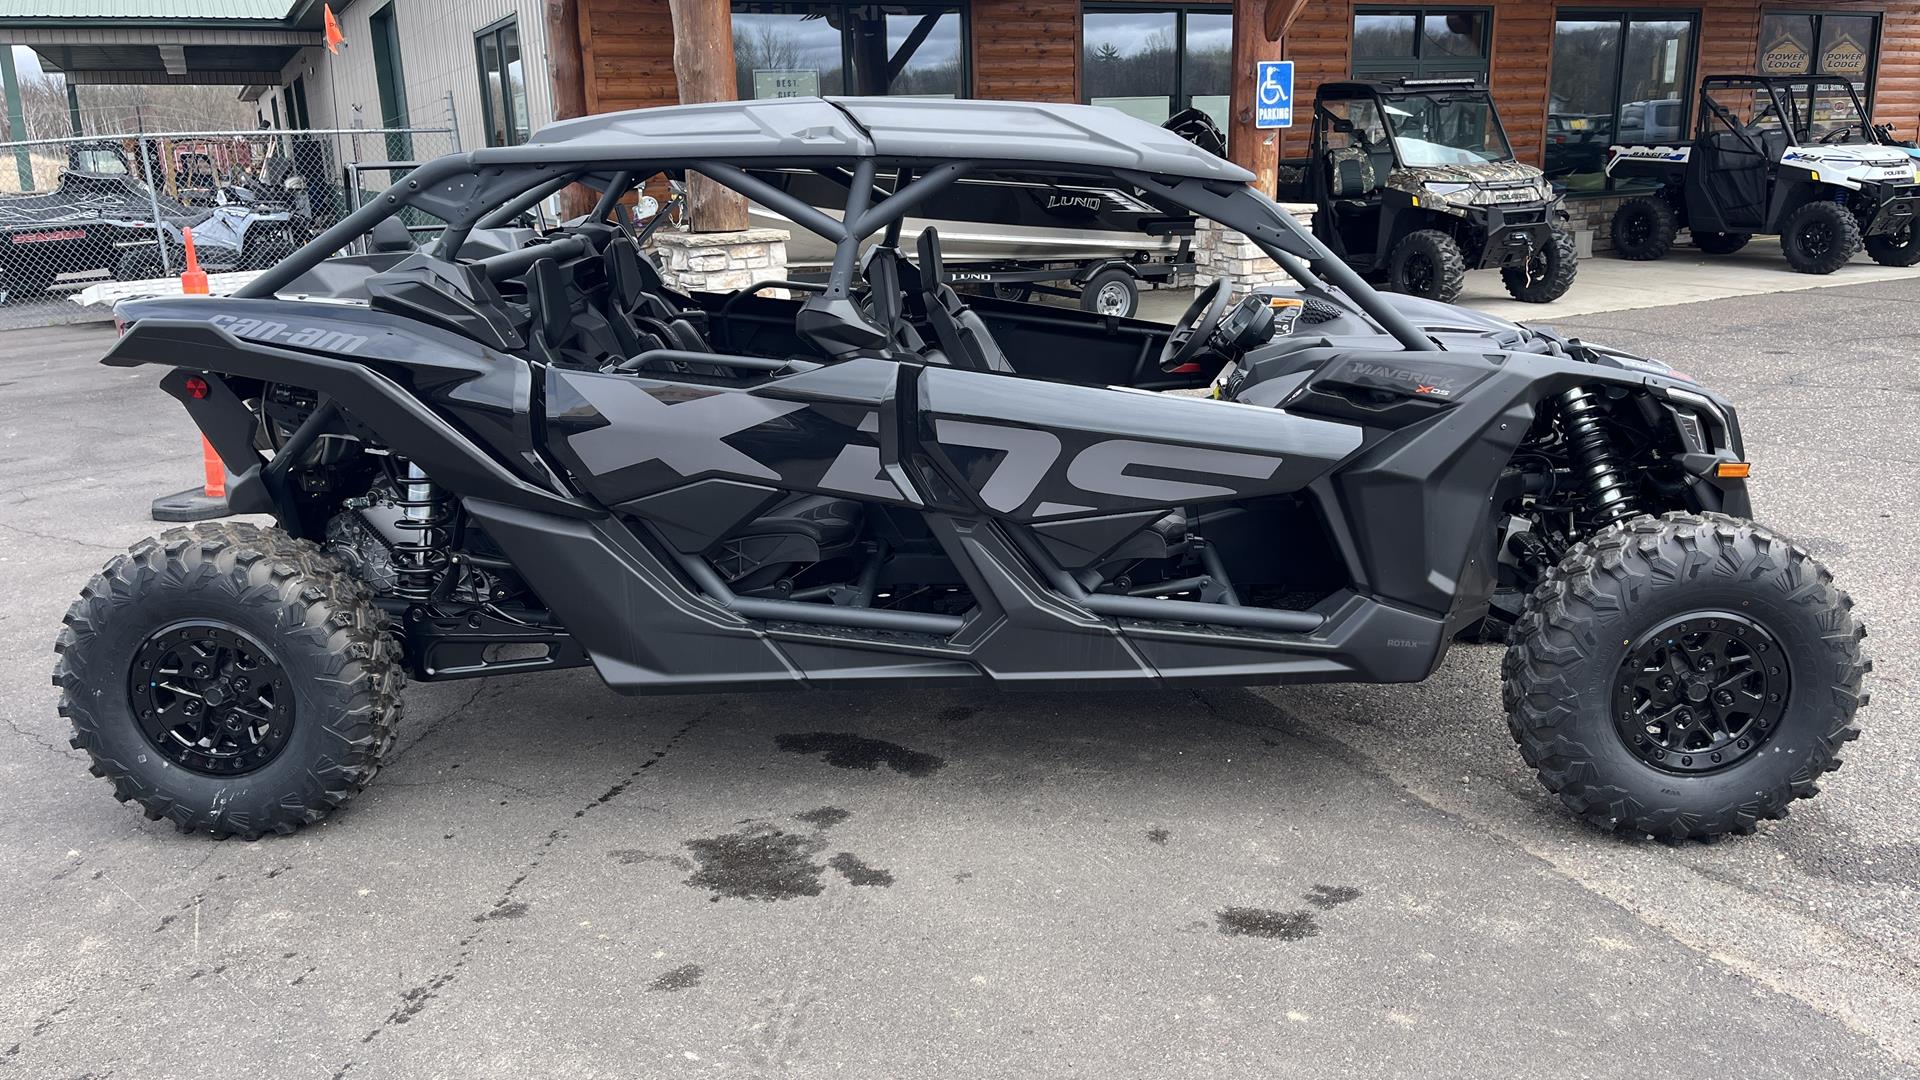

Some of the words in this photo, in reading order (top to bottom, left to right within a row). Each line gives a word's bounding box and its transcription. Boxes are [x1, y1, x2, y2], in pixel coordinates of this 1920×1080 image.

[1766, 53, 1807, 61] POWER
[1826, 53, 1863, 61] POWER
[1768, 61, 1803, 69] LODGE
[1827, 60, 1860, 68] LODGE
[1259, 107, 1290, 120] PARKING
[1047, 195, 1101, 211] LUND
[951, 273, 991, 282] LUND
[1352, 362, 1455, 389] MAVERICK
[1386, 639, 1418, 648] ROTAX
